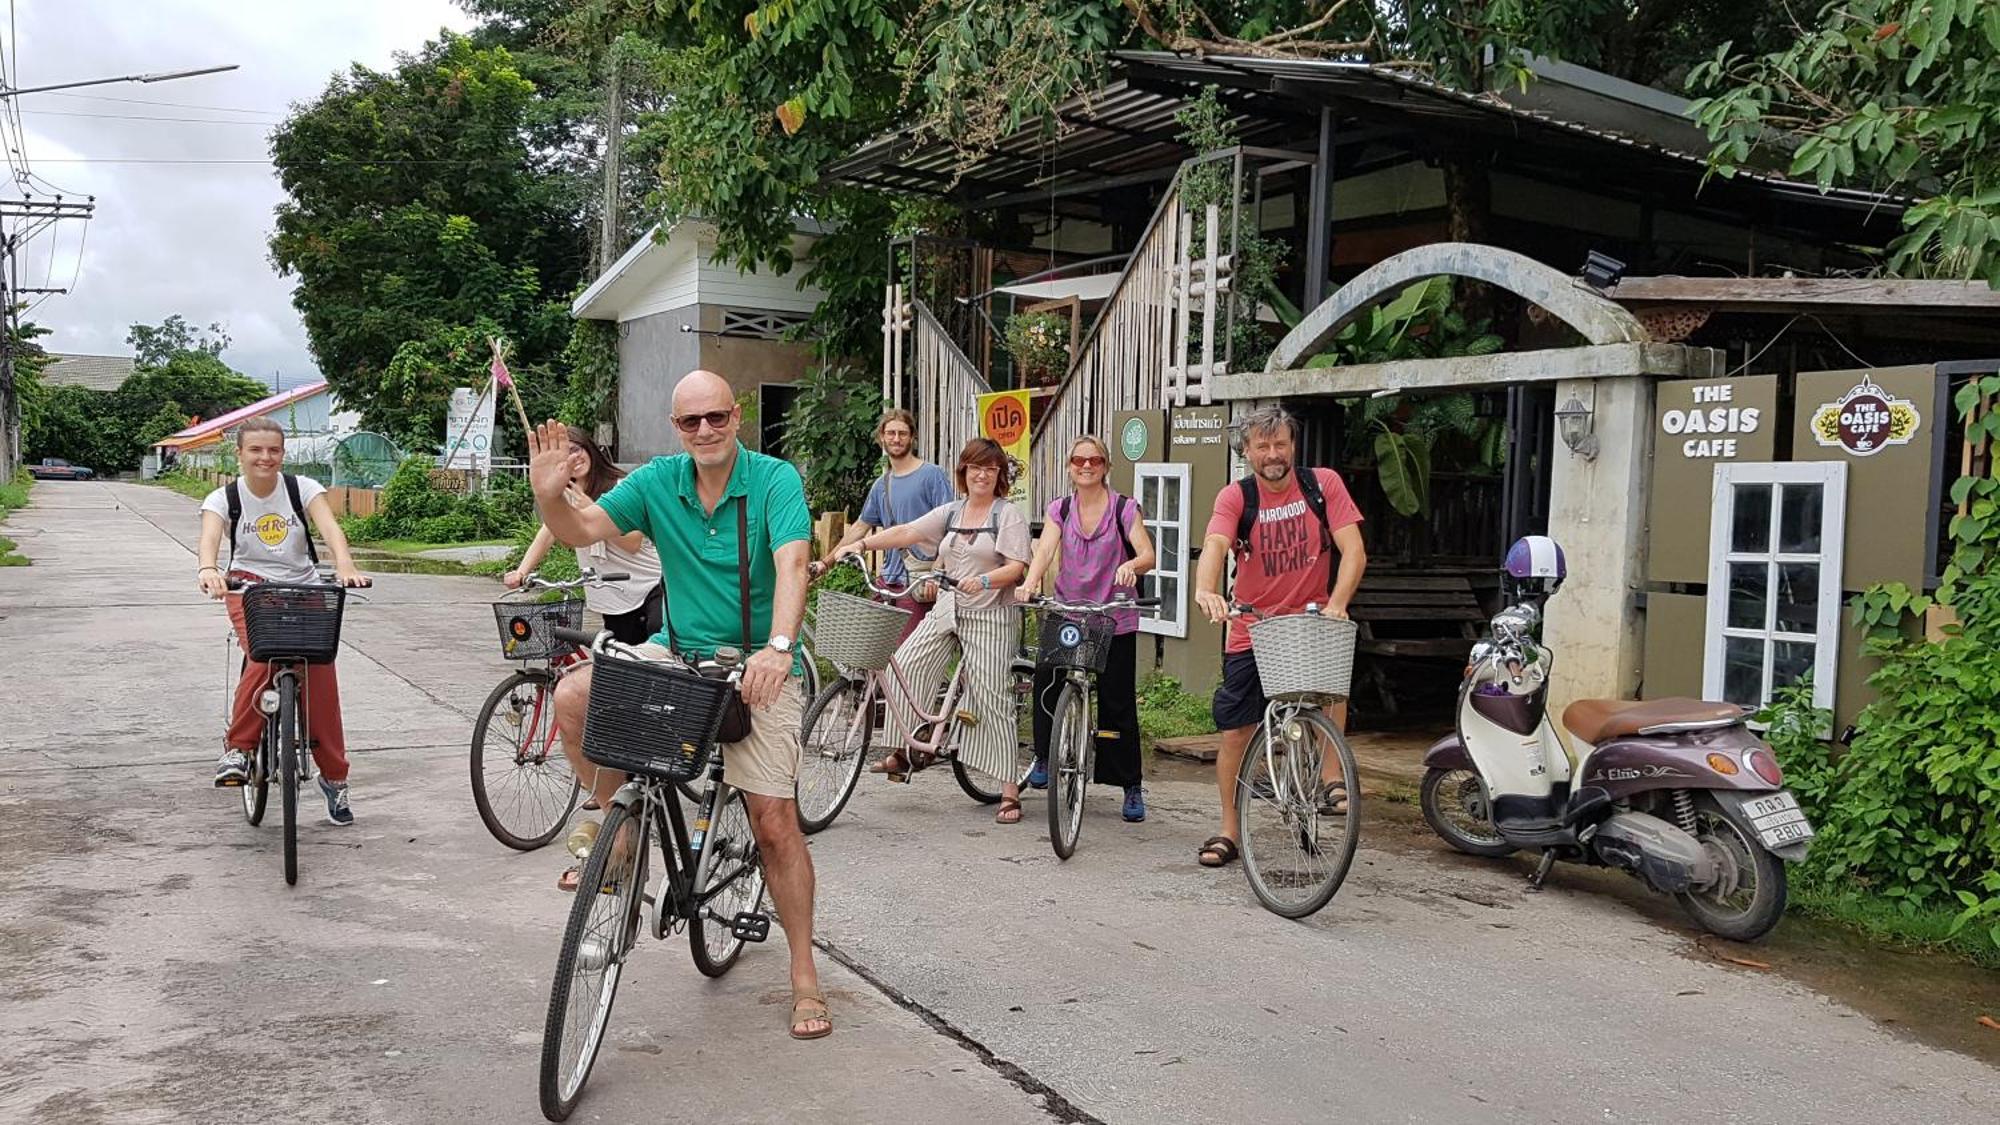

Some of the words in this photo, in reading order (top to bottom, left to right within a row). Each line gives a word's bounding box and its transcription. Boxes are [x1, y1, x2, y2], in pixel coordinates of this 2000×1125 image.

[1692, 384, 1732, 404] THE
[1855, 403, 1877, 412] THE
[992, 404, 1022, 430] เปิด
[1662, 407, 1760, 434] OASIS
[1840, 411, 1889, 425] OASIS
[1850, 424, 1879, 433] CAFE
[1683, 439, 1737, 457] CAFE
[1259, 500, 1306, 523] HARDWOOD
[271, 514, 299, 531] Rock
[1260, 515, 1308, 552] HARD
[1773, 824, 1803, 841] 280
